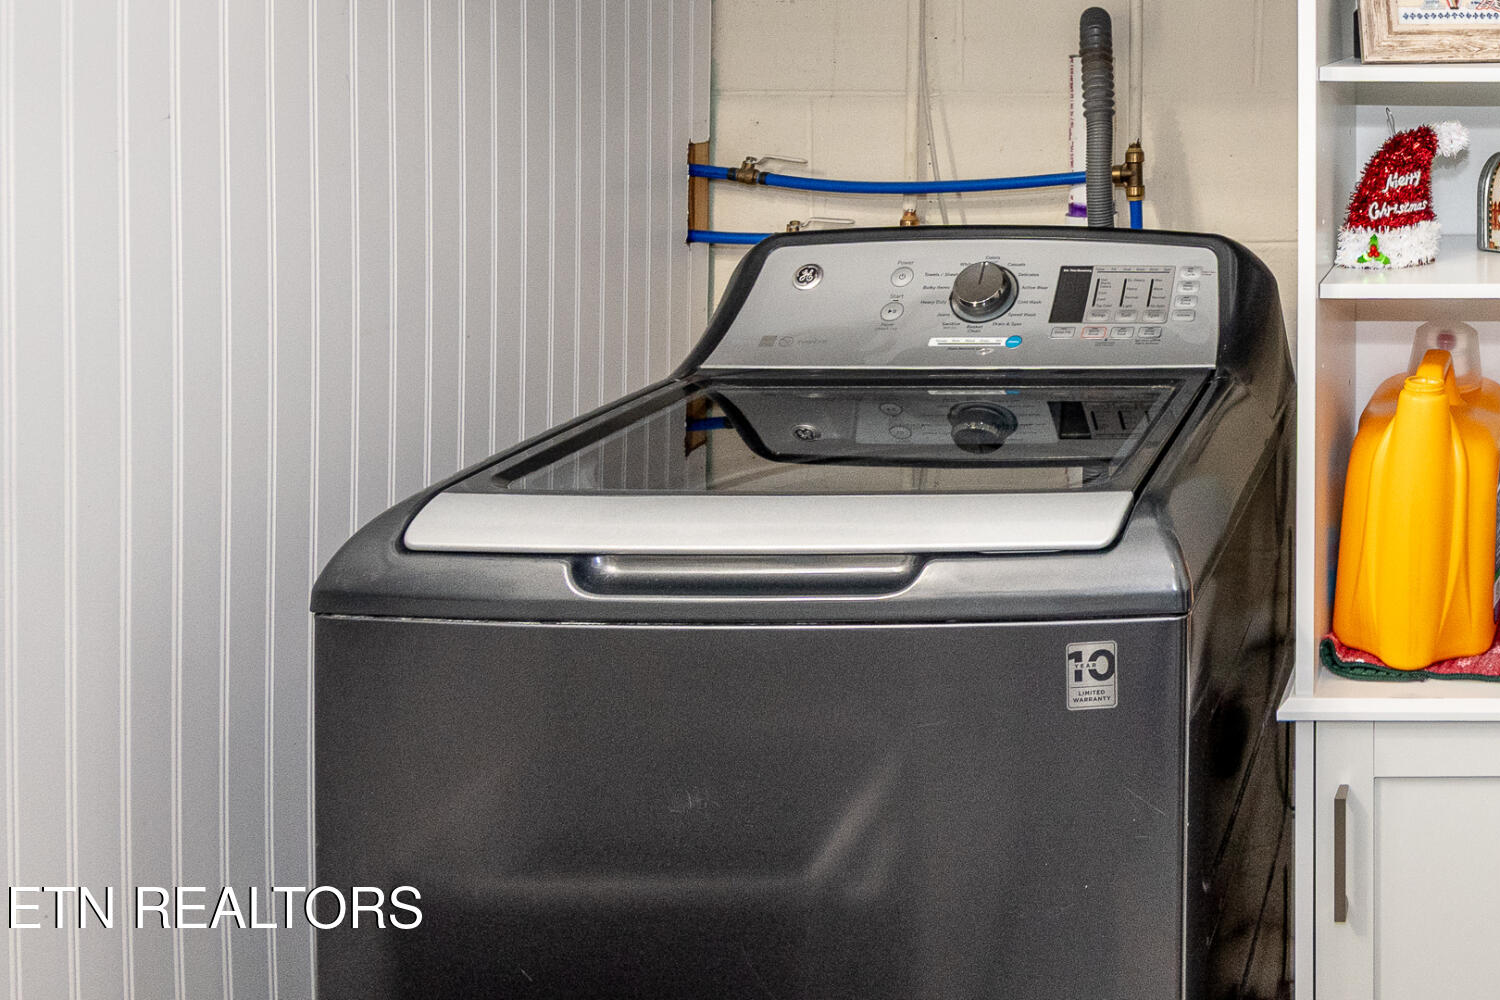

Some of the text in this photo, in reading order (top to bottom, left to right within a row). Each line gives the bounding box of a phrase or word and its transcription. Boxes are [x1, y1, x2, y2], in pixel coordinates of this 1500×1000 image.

[1382, 169, 1421, 193] Merry
[1368, 200, 1428, 220] Christmas
[1068, 649, 1115, 682] 10
